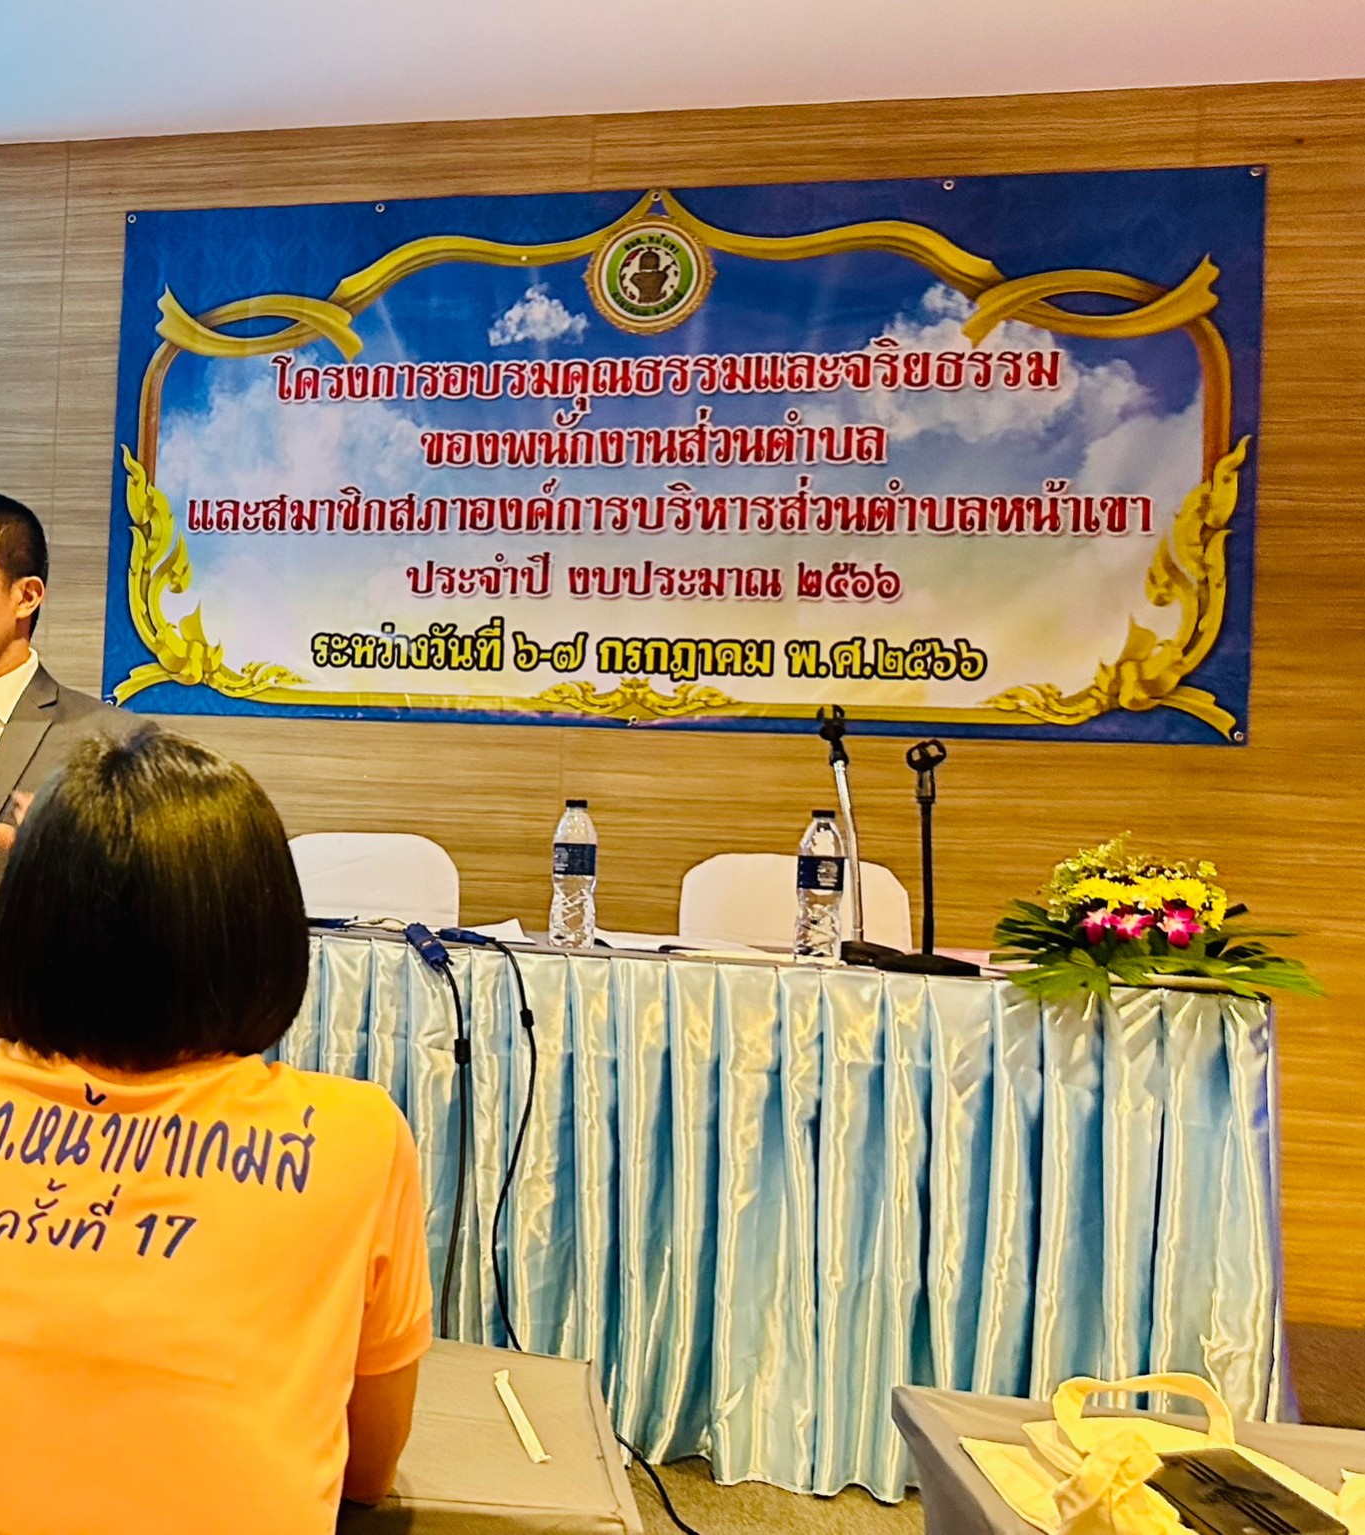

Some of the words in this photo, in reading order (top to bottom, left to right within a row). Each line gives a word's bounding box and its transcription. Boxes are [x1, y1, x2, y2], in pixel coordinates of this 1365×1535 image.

[272, 337, 1062, 411] โครงการอบรมคุณธรรมและจริยธรรม
[420, 407, 887, 466] ของพนักงานส่วนตำบล
[187, 476, 1153, 537] และสมาชิกสภาองค์การบริหารส่วนตำบลหน้าเขา
[406, 552, 550, 595] ประจำปี
[568, 564, 783, 599] งบประมาณ
[797, 562, 903, 602] ๒๕๖๖
[310, 616, 505, 672] ระหว่างวันที่
[512, 631, 589, 673] ๖-๗
[596, 637, 775, 682] กรกฎาคม
[136, 1213, 197, 1259] 17
